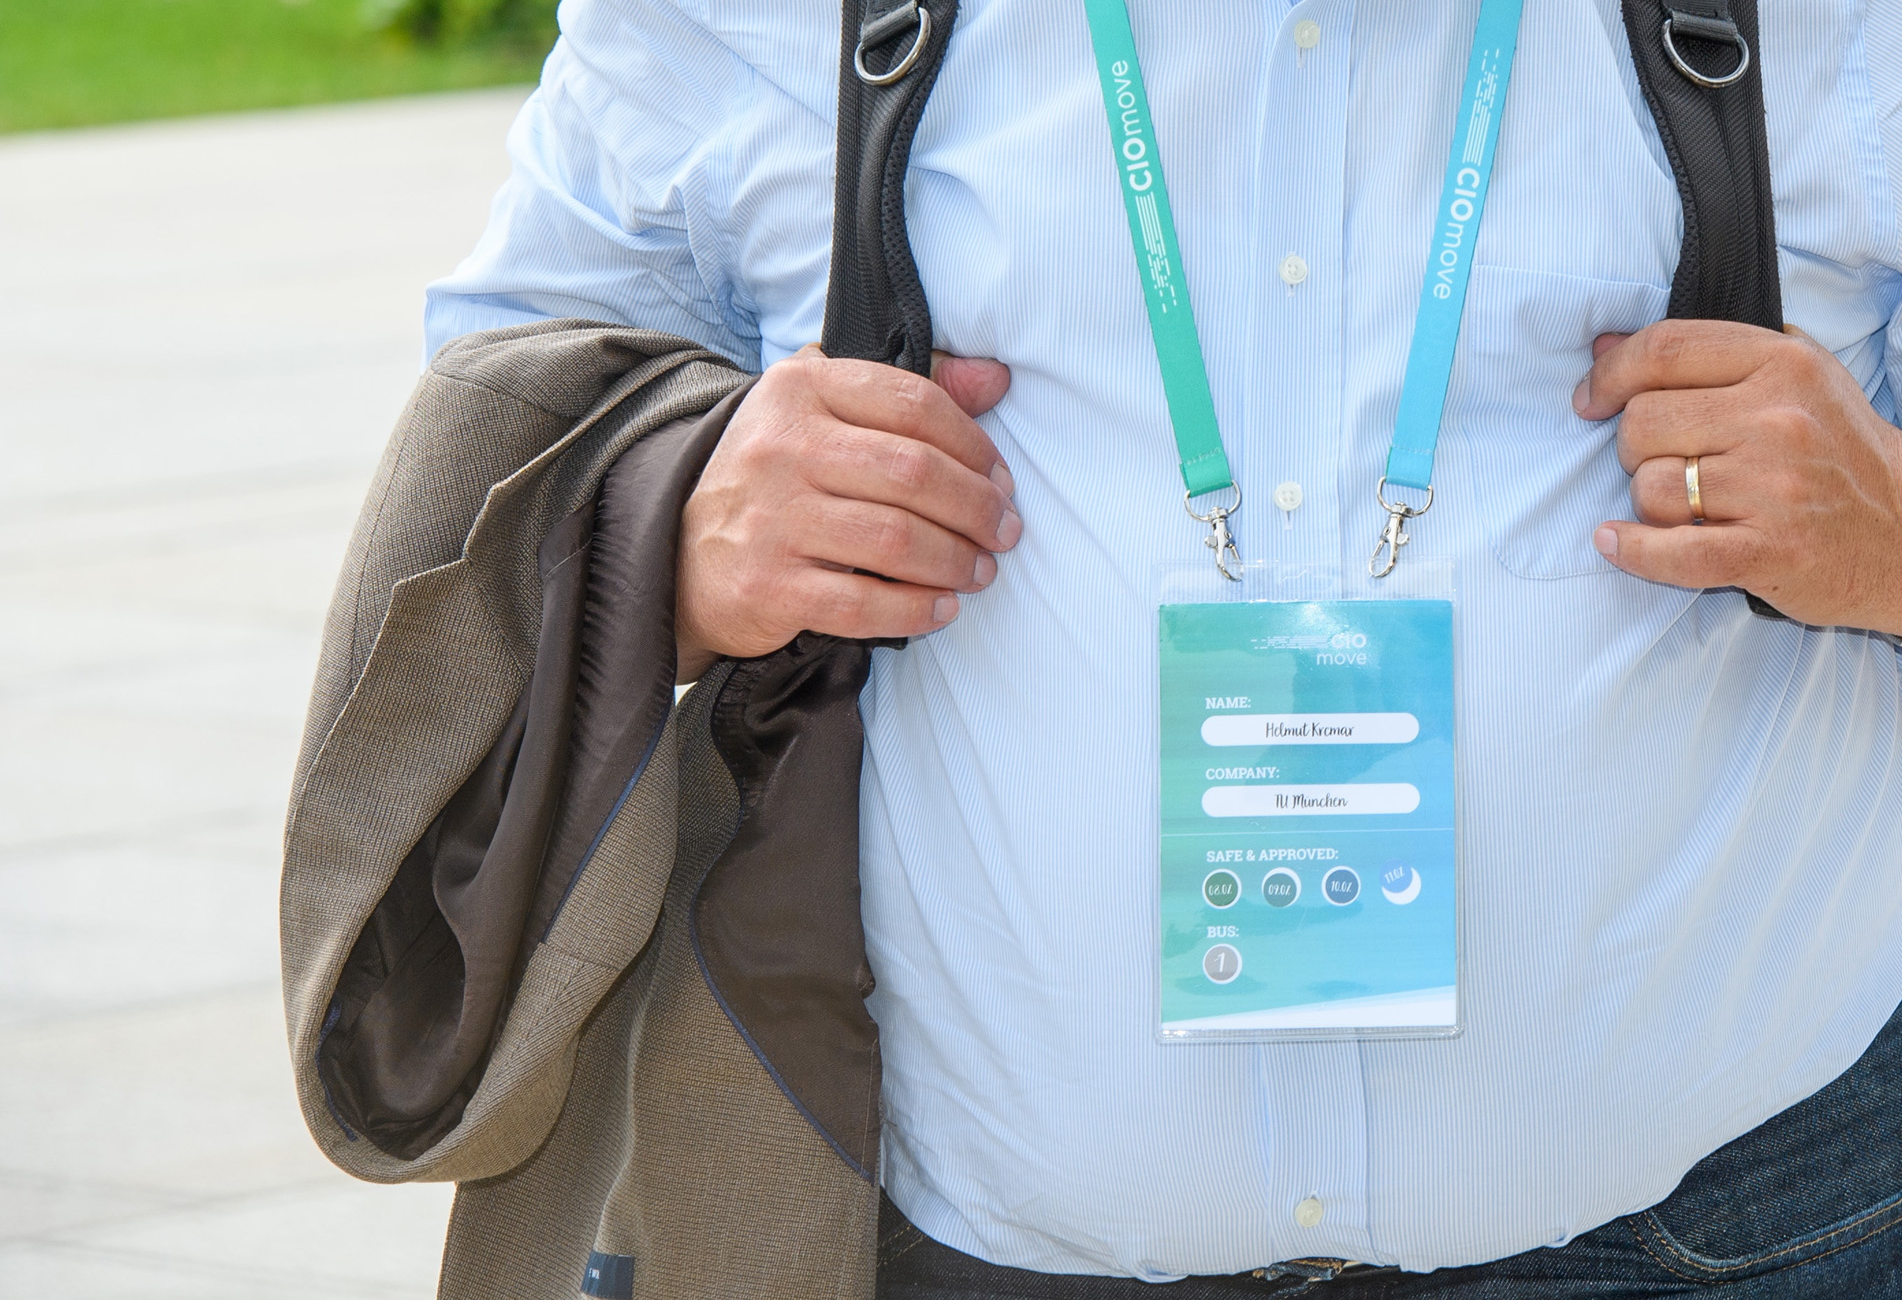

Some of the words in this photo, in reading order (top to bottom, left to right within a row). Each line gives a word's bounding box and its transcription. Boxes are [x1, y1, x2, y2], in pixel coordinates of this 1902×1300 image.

[1111, 59, 1153, 192] CIOmove
[1433, 167, 1480, 300] CIOmove
[1316, 652, 1367, 666] move
[1205, 697, 1251, 709] NAME:
[1265, 722, 1309, 738] Helmut
[1205, 767, 1280, 780] COMPANY:
[1292, 794, 1348, 809] München
[1206, 850, 1243, 862] SAFE
[1246, 850, 1256, 861] &
[1258, 849, 1339, 861] APPROVED:
[1207, 926, 1239, 938] BUS:
[1214, 952, 1226, 973] 1
